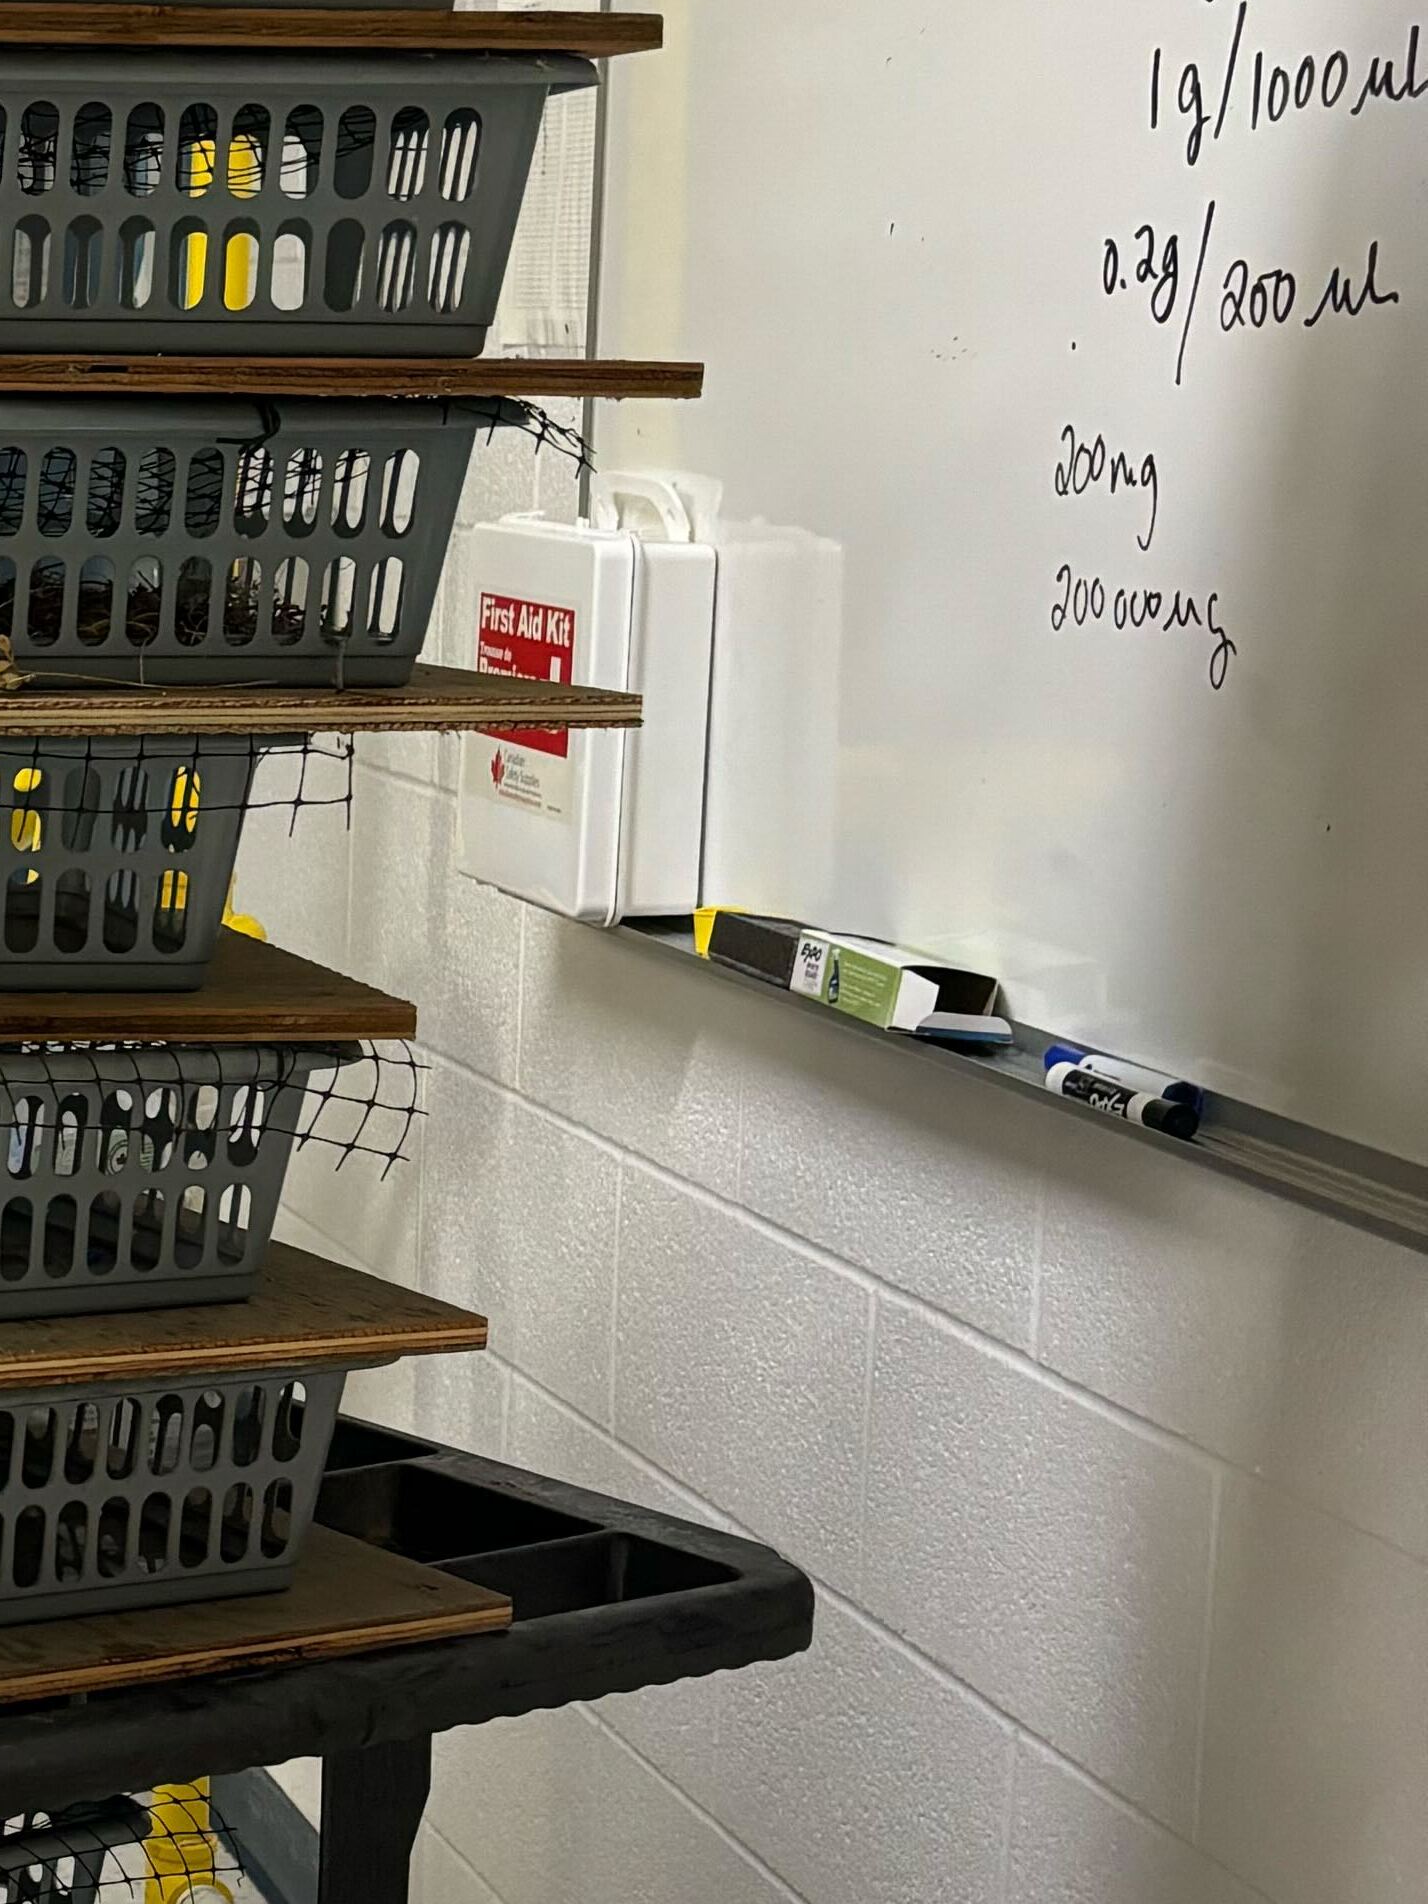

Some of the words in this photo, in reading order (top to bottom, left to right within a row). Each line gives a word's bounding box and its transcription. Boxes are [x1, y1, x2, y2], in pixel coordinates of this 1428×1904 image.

[481, 596, 515, 636] First
[516, 603, 543, 642] Aid
[545, 608, 571, 649] Kit
